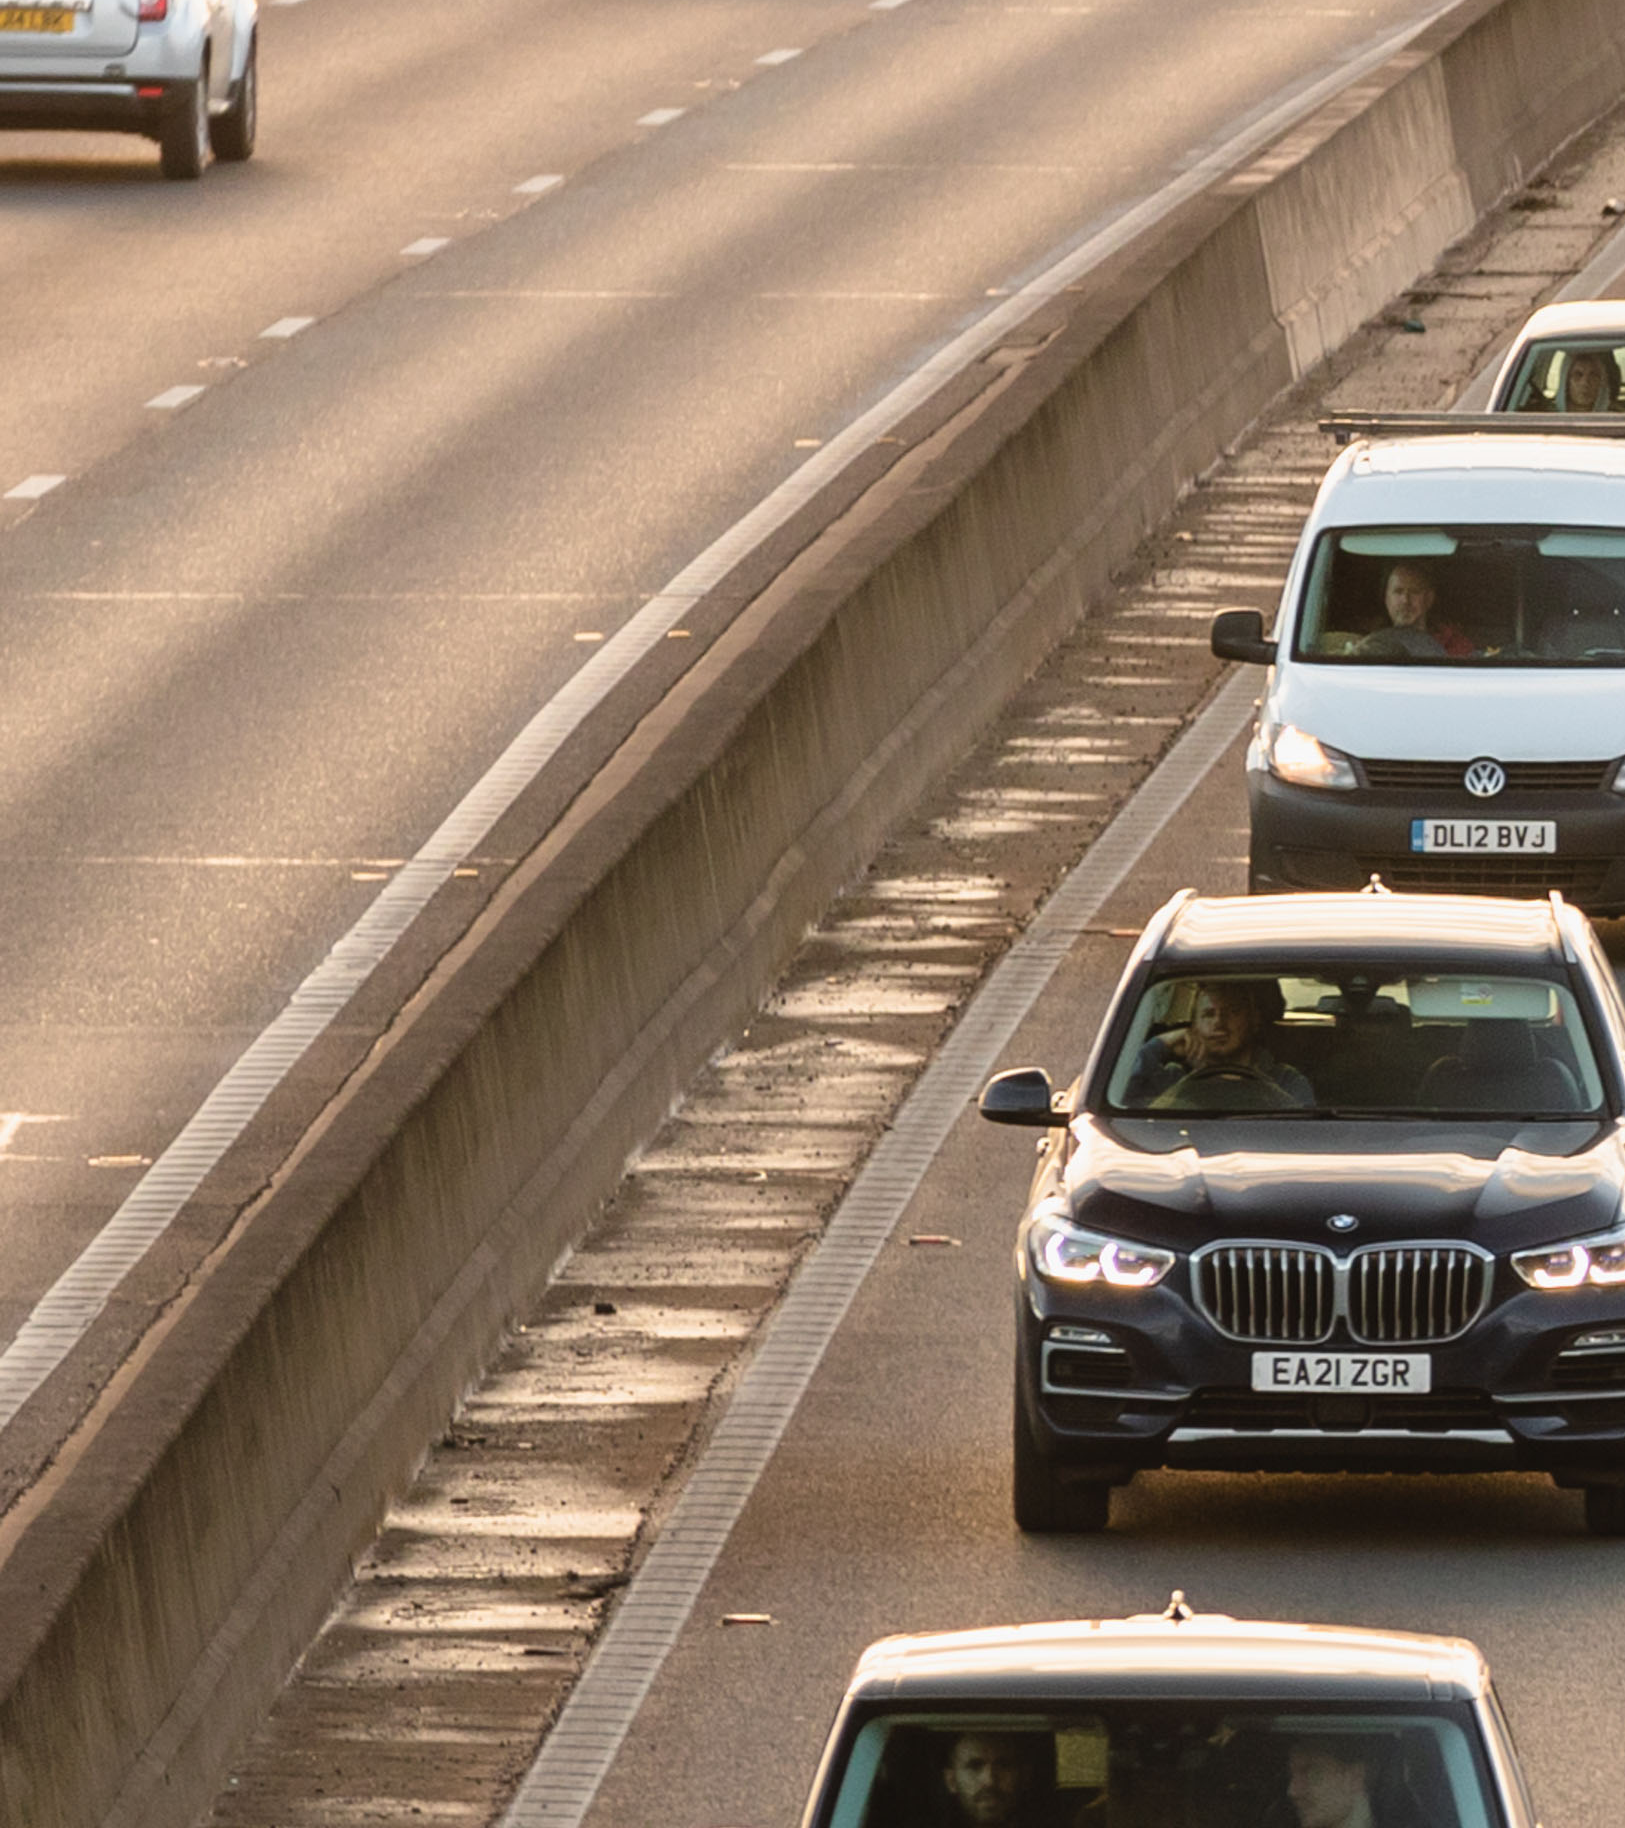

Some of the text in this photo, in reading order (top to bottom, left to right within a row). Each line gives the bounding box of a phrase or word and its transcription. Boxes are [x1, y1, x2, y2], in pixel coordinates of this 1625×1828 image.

[1434, 824, 1547, 849] DL12 BVJ
[1272, 1359, 1411, 1386] EA21 ZGR
